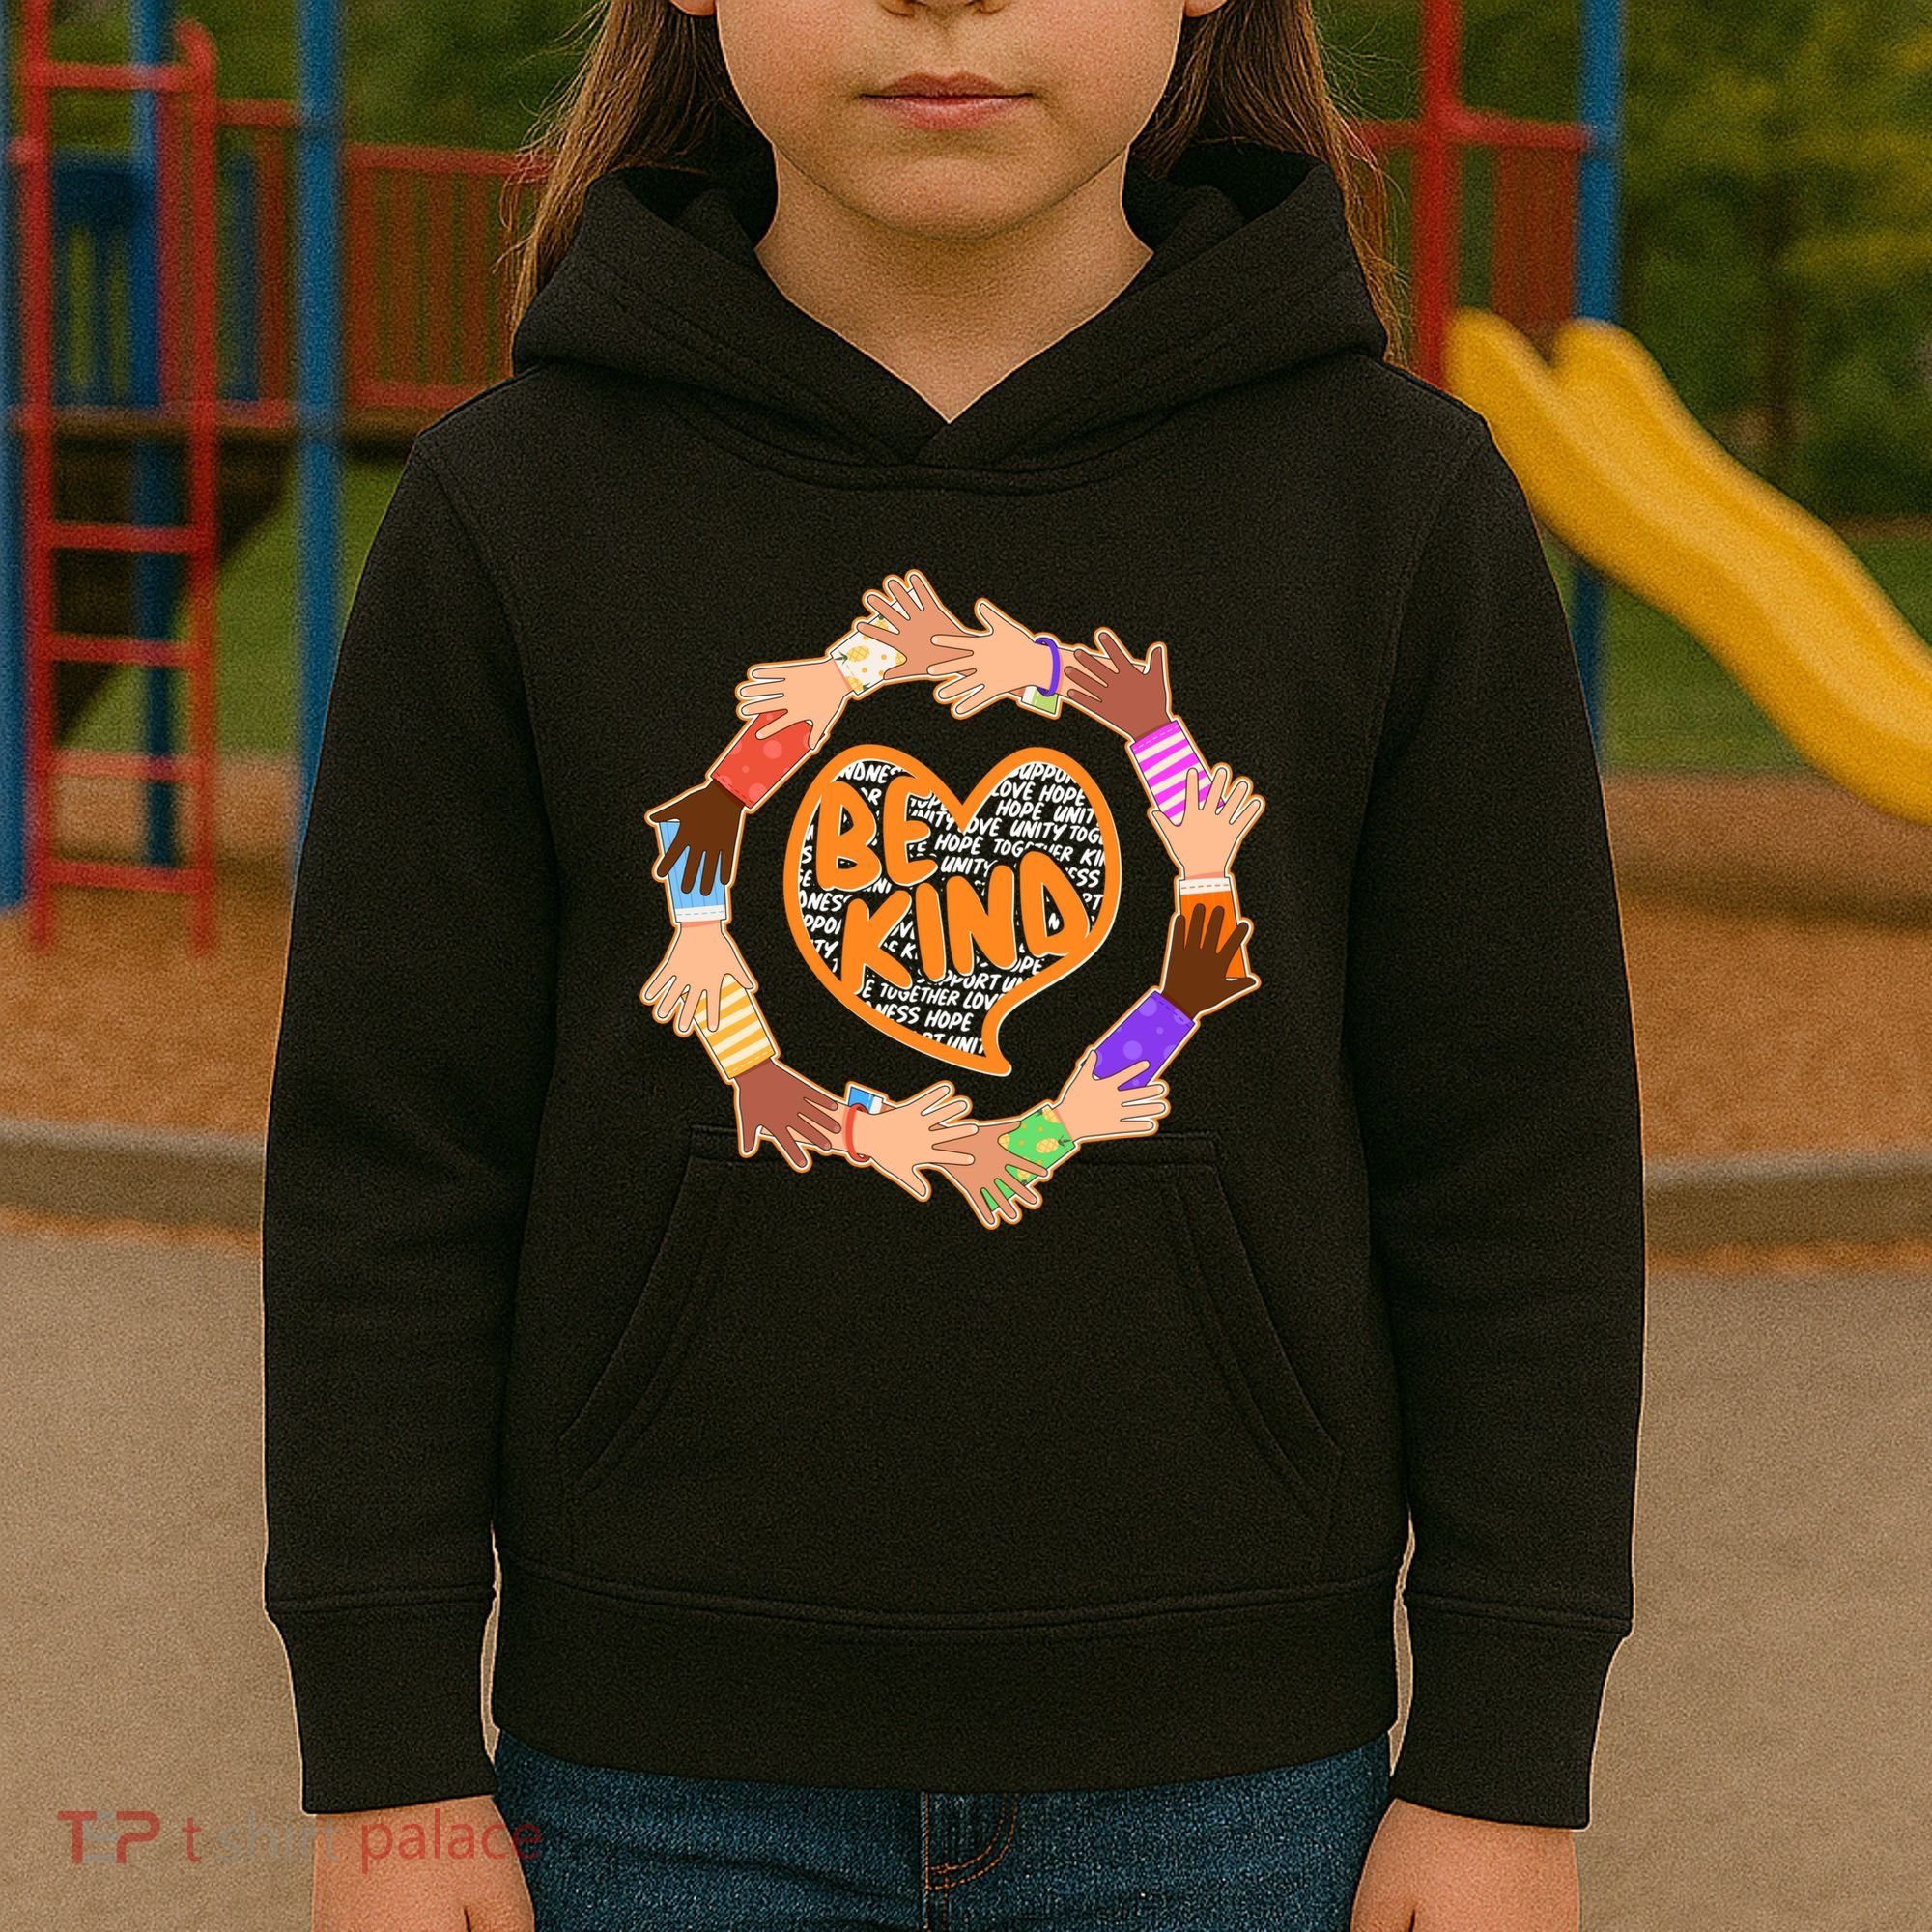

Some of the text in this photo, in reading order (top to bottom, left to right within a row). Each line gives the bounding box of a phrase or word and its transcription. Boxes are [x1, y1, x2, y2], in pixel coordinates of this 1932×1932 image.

[1038, 783, 1086, 806] HOPE
[995, 799, 1100, 827] HOPE UNIT
[816, 775, 938, 891] BE
[958, 817, 1002, 837] OVE
[1009, 819, 1068, 842] UNITY
[934, 832, 983, 855] HOPE
[941, 856, 998, 877] UNITY
[841, 850, 1091, 992] KIND
[880, 983, 960, 1006] TOGETHER
[963, 991, 1006, 1011] LOV
[924, 1009, 974, 1032] HOPE
